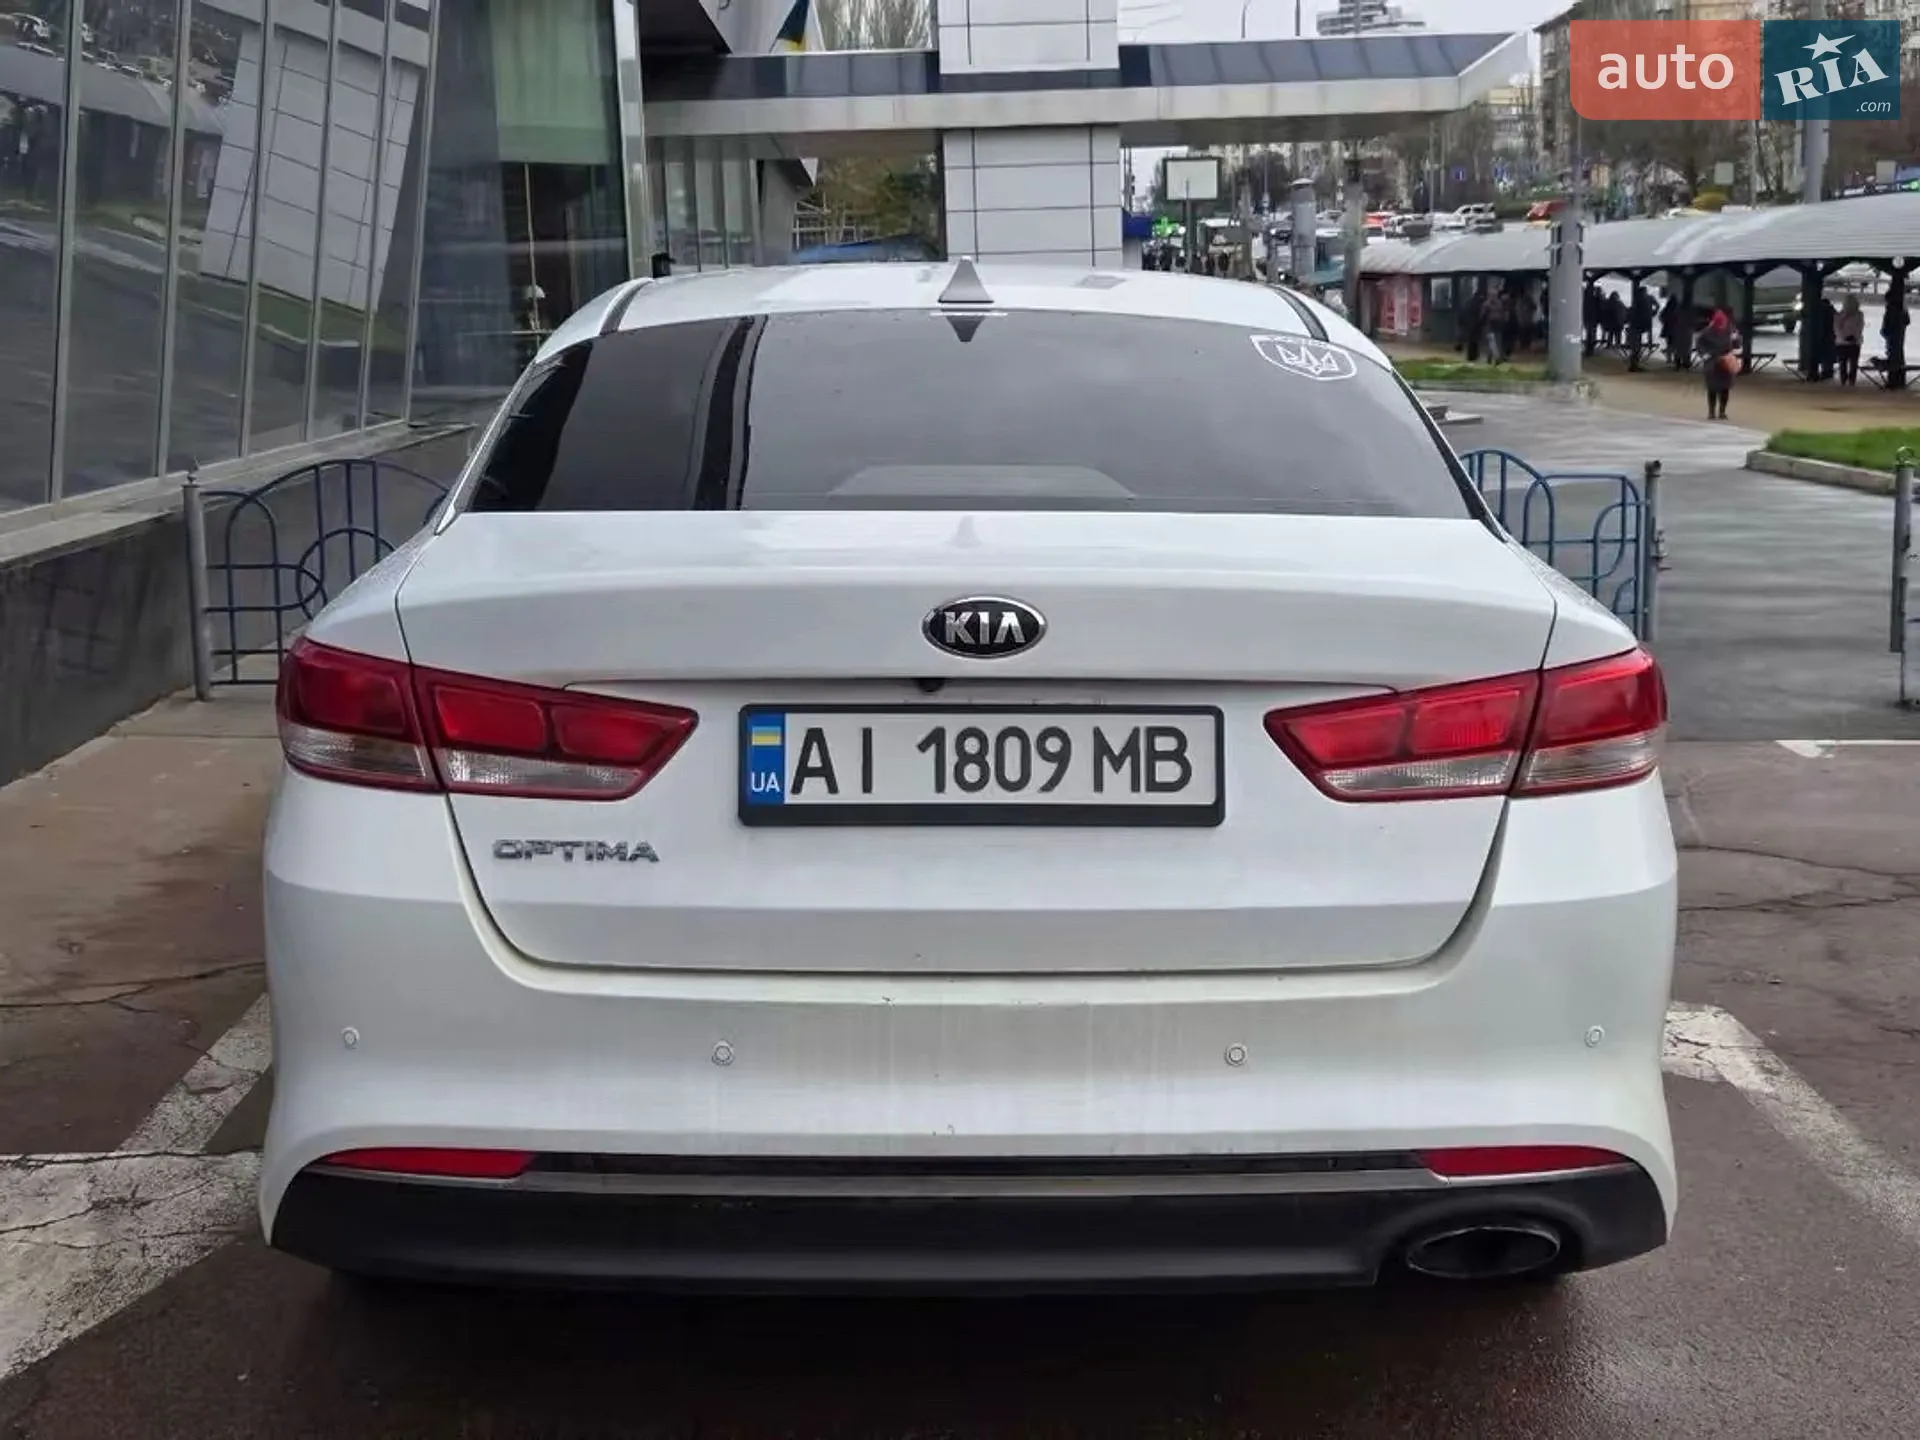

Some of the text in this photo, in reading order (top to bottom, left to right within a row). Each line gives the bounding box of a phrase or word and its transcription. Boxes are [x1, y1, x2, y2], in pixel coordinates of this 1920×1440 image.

[943, 611, 1026, 645] KIA
[790, 726, 1193, 794] AI 1809 MB
[751, 771, 780, 793] UA
[493, 839, 660, 862] OPTIMA
